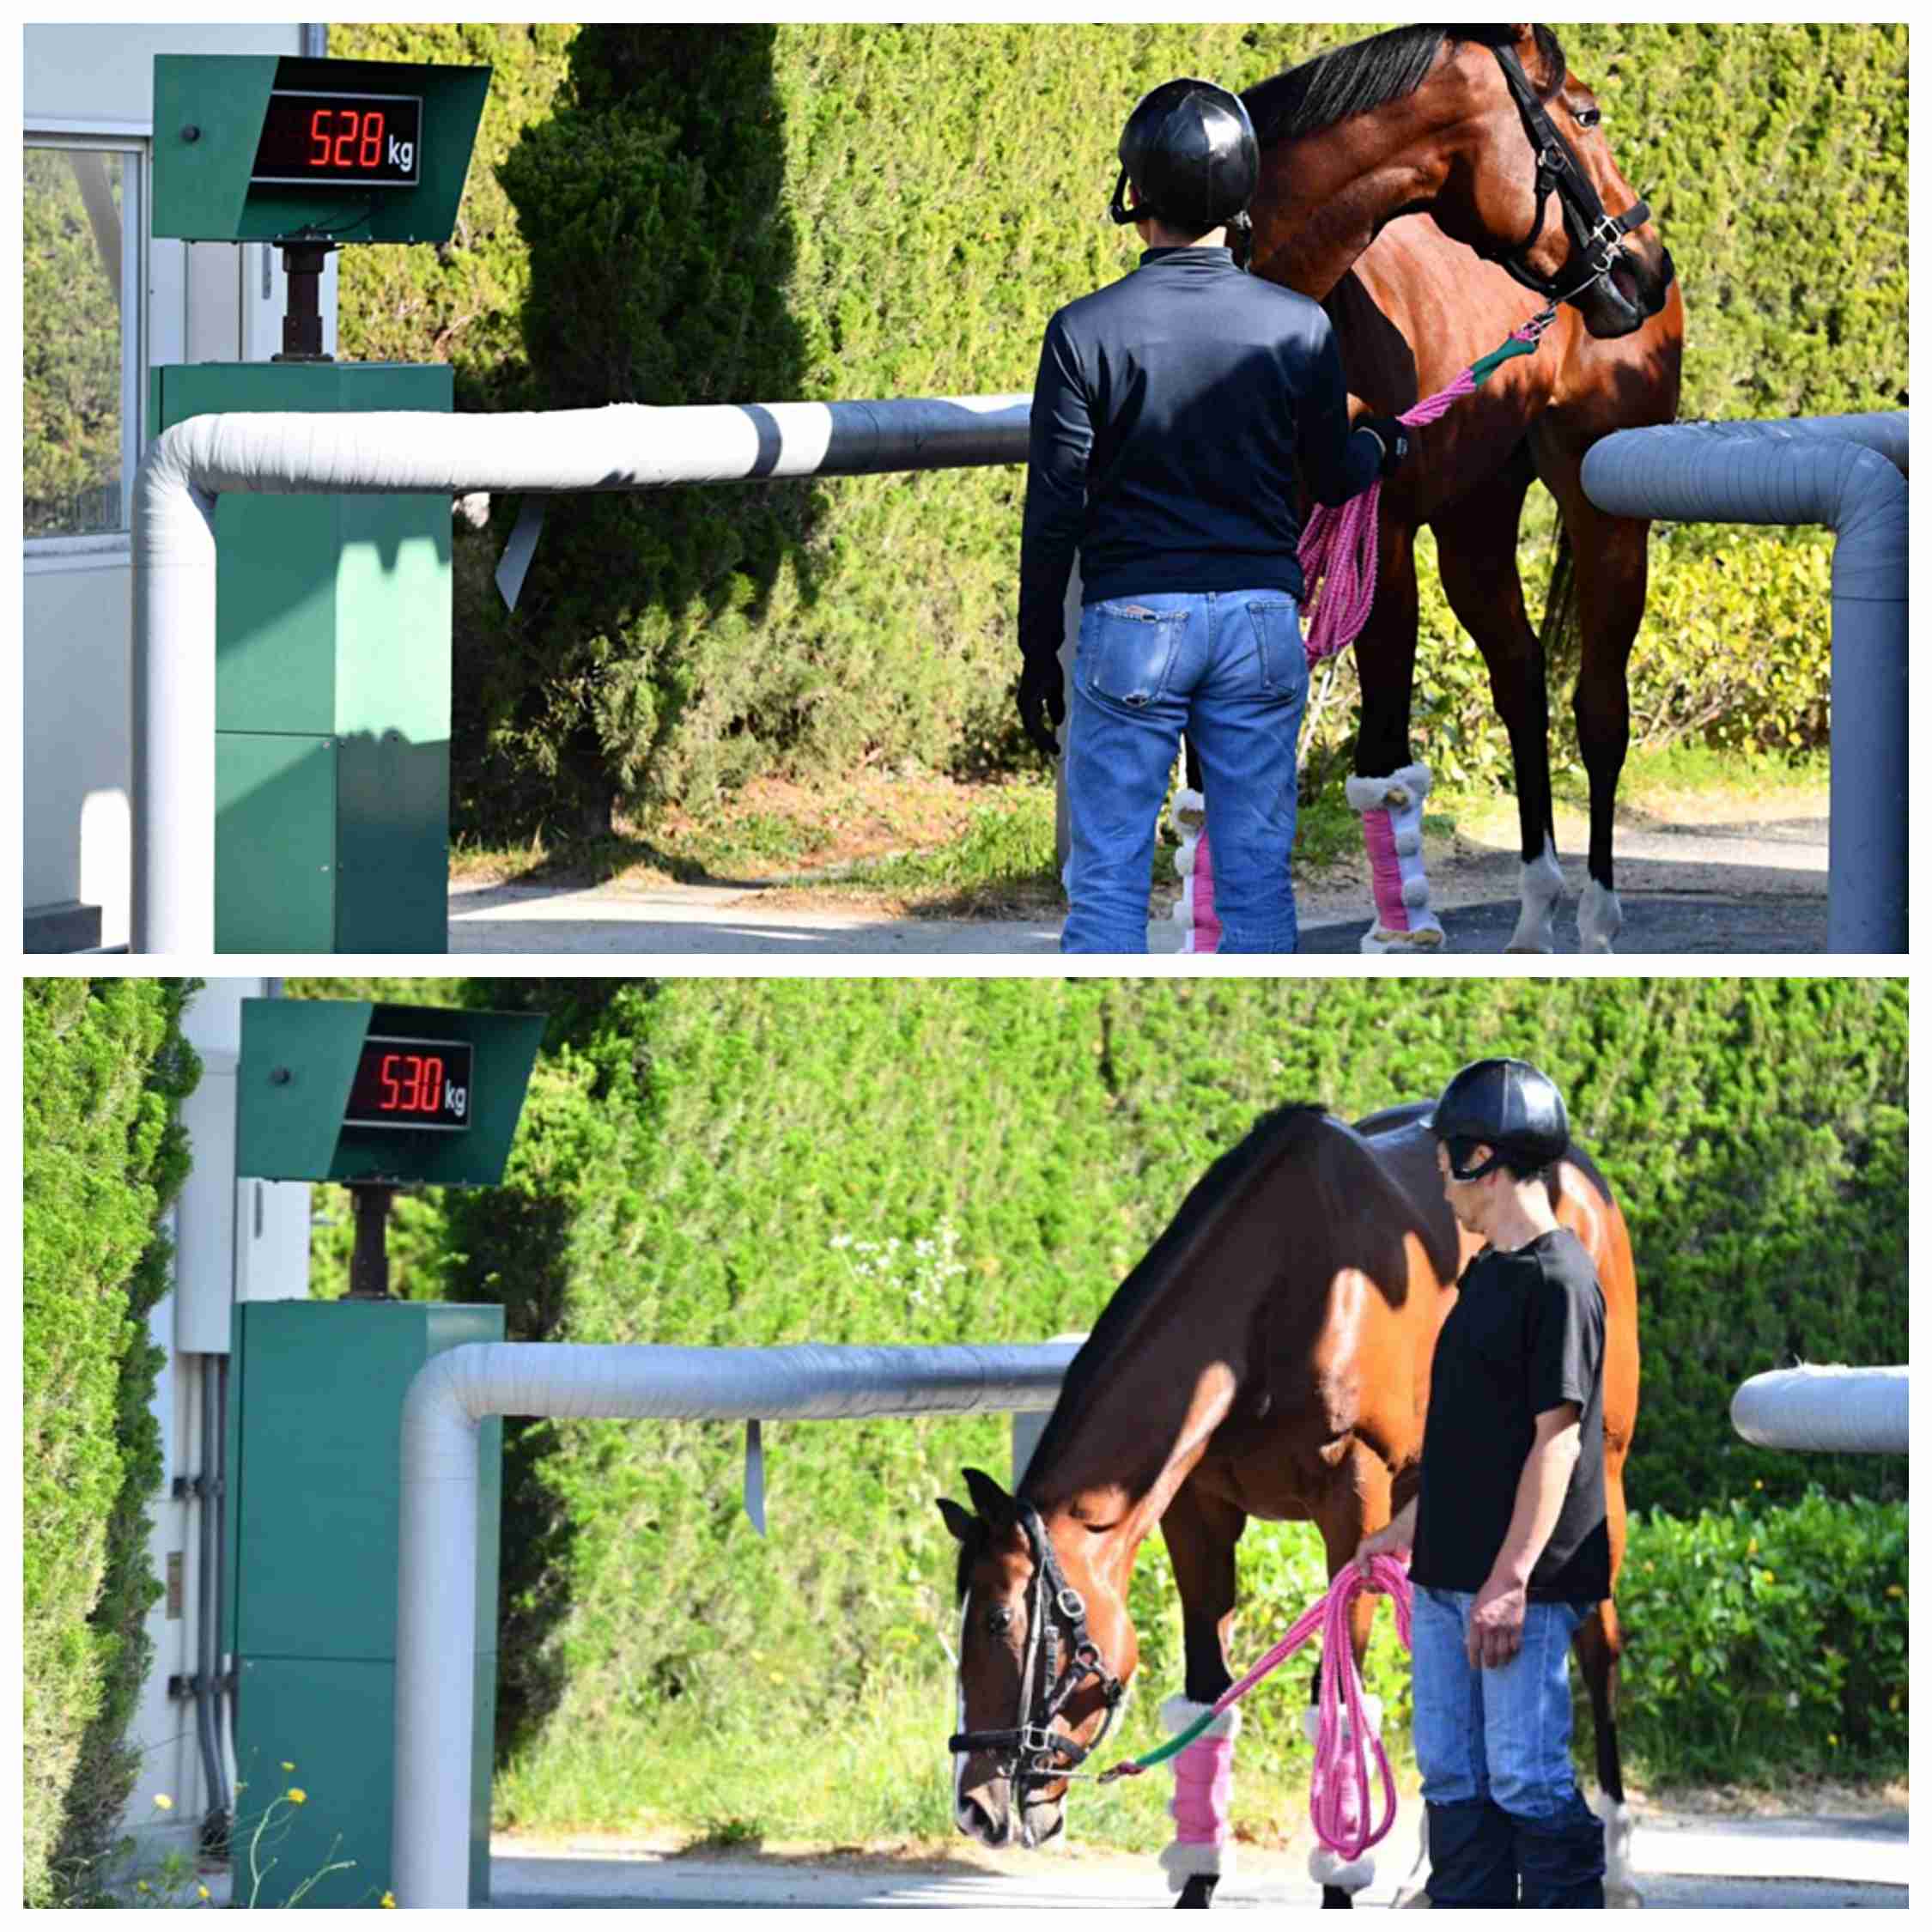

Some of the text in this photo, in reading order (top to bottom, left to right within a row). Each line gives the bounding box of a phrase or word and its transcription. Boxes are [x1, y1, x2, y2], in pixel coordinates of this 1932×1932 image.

[309, 109, 414, 172] 528 kg
[380, 1054, 466, 1117] 530 kg
